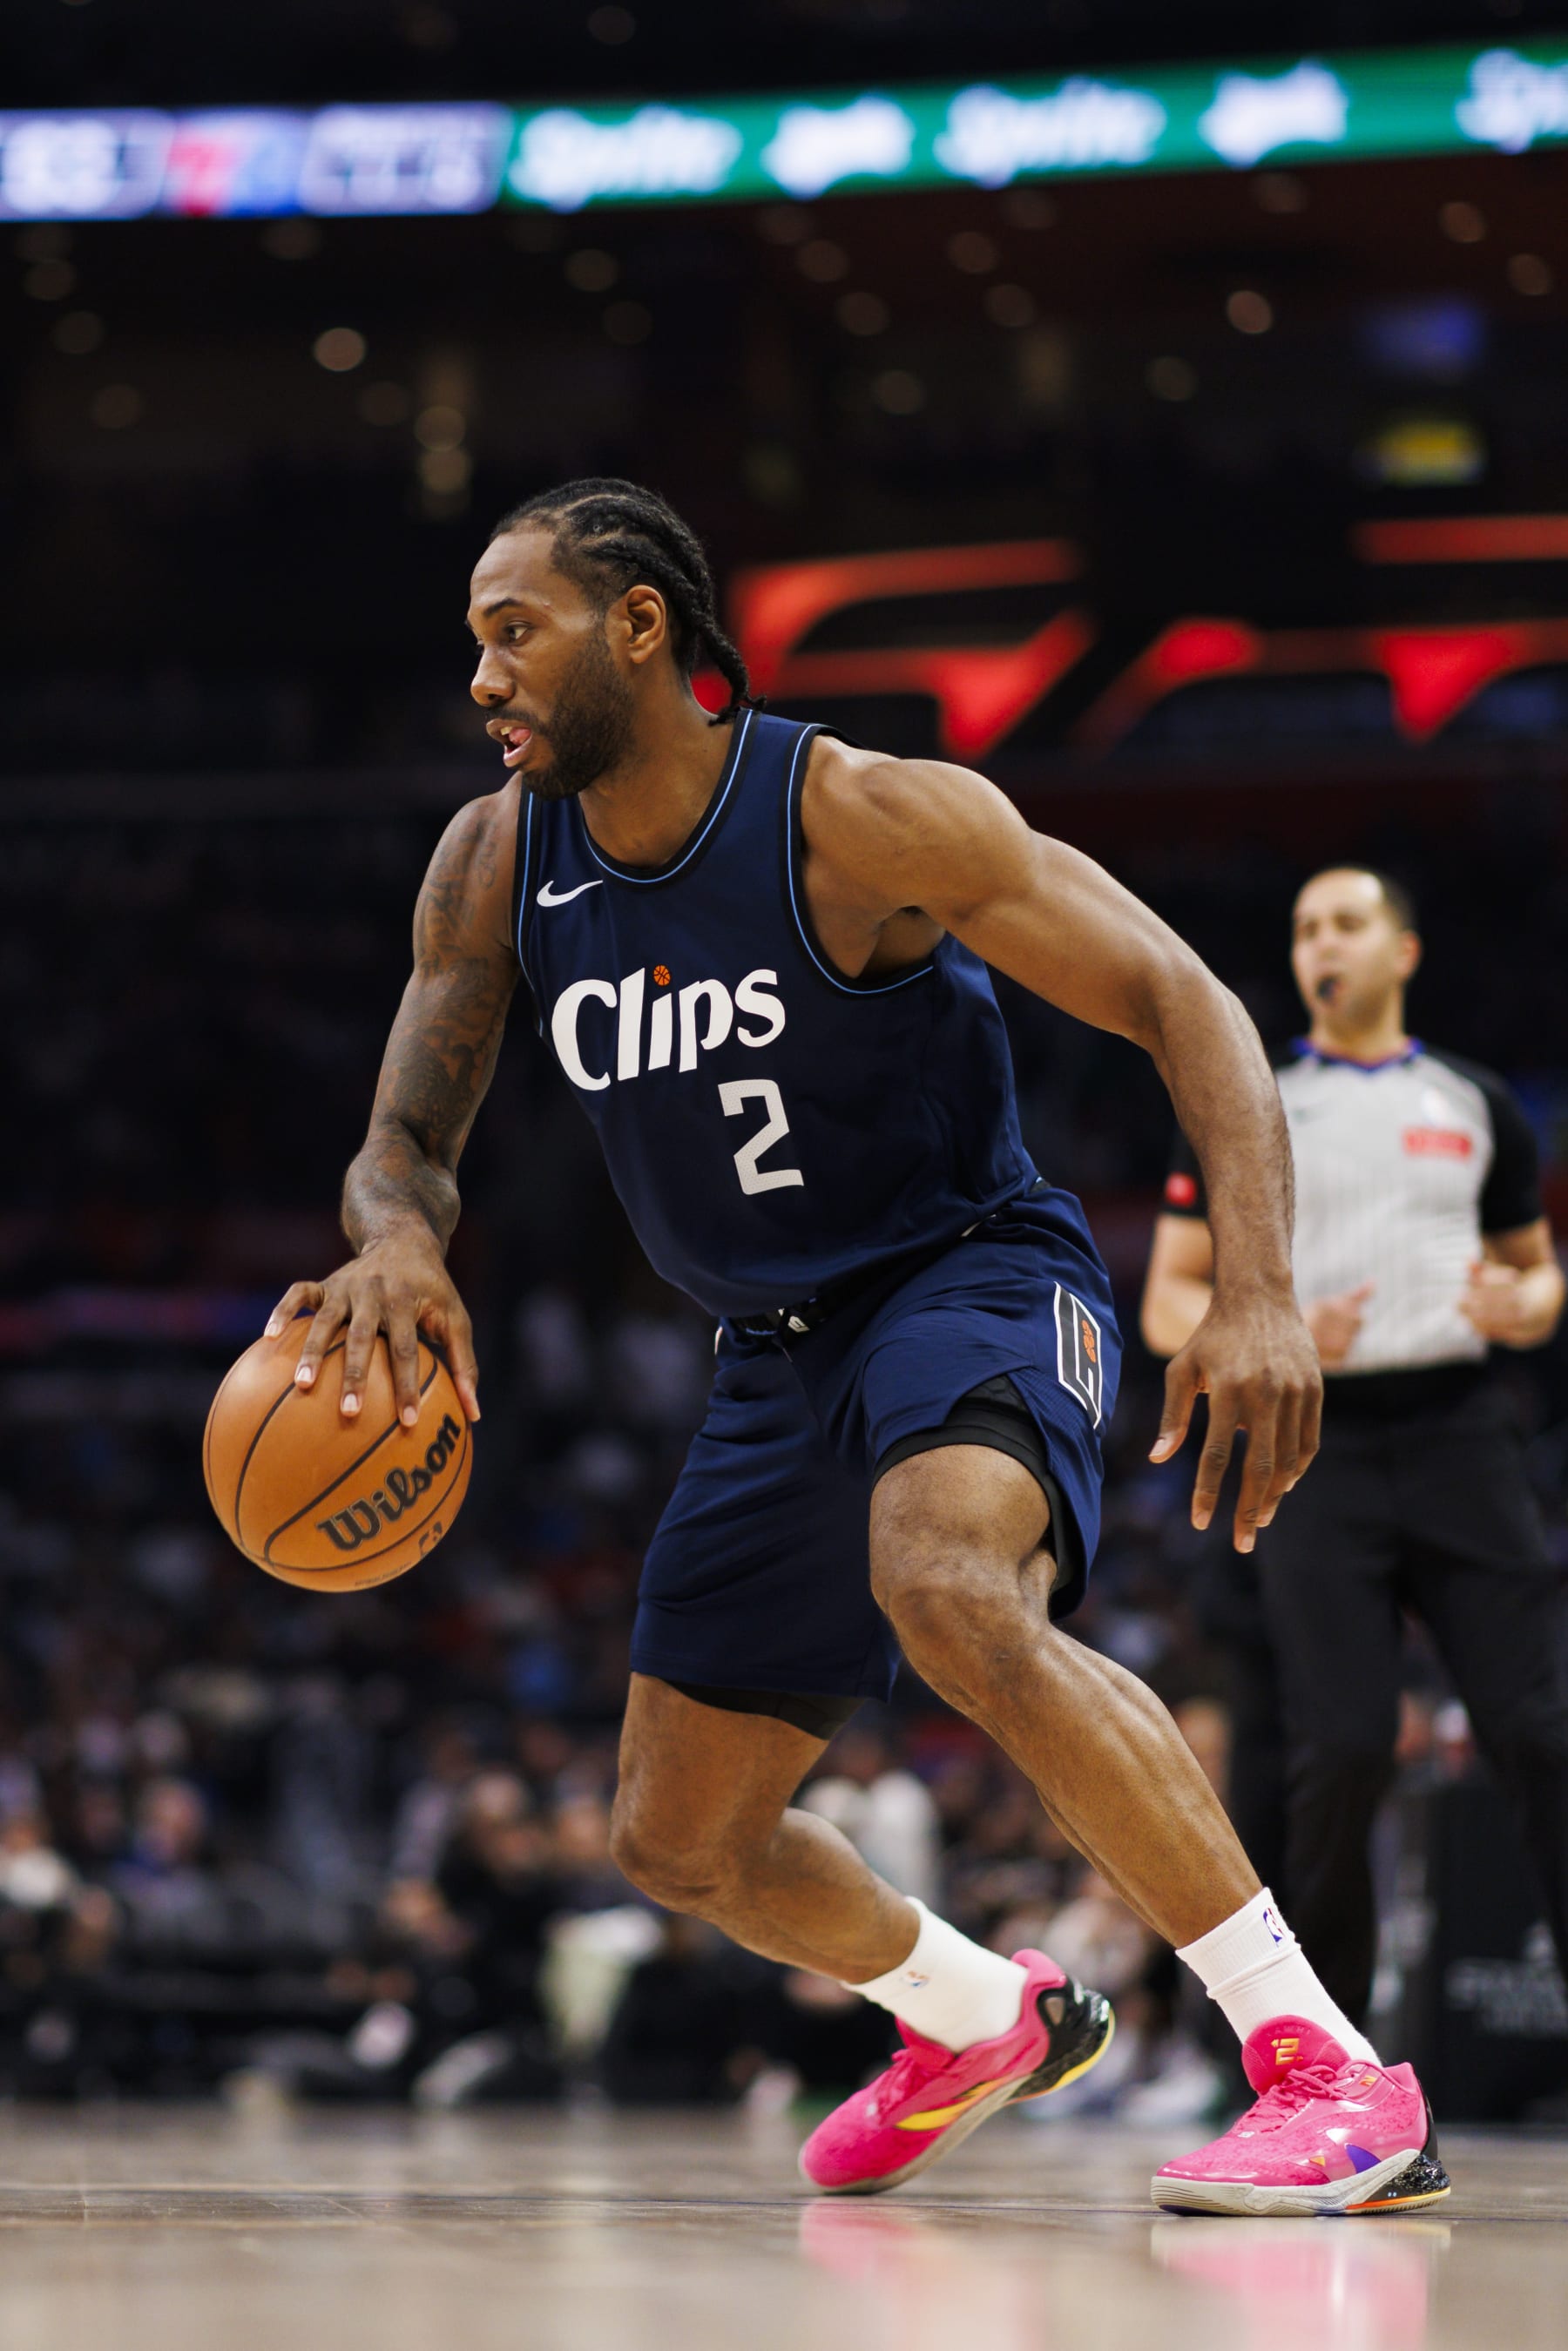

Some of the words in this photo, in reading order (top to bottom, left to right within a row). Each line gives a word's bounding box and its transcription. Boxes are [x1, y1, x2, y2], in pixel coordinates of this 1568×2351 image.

[551, 964, 786, 1091] Clips
[718, 1078, 804, 1195] 2
[315, 1413, 461, 1550] Wilson
